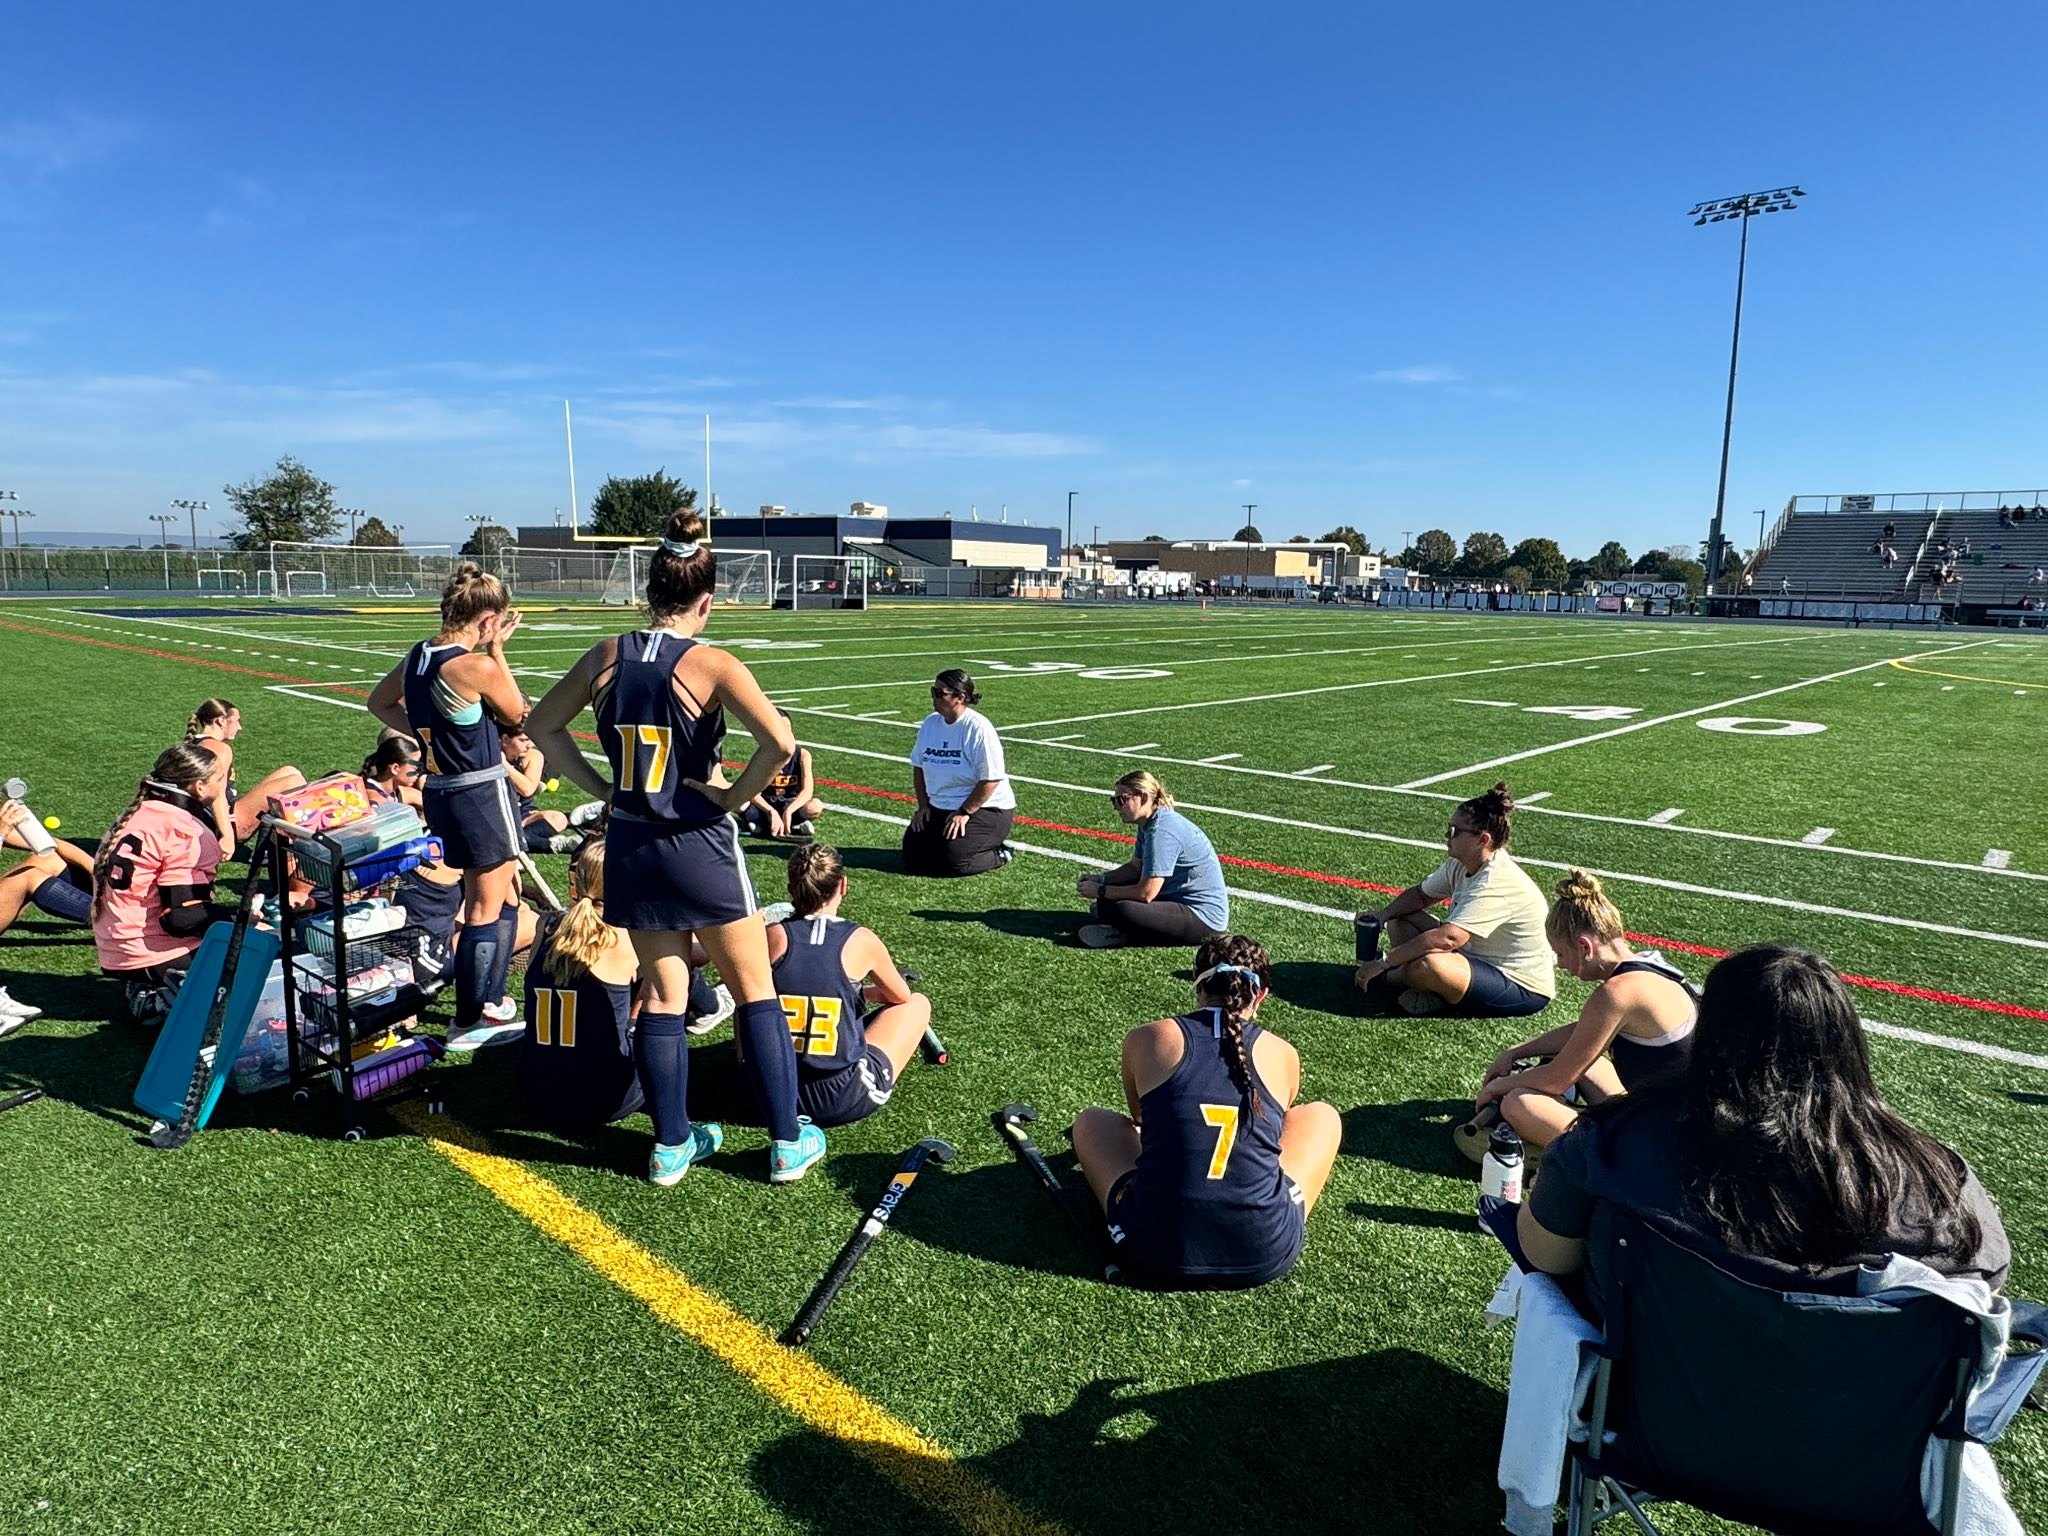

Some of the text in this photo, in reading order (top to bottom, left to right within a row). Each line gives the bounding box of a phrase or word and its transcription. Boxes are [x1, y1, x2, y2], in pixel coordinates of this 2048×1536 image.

[1521, 705, 1828, 736] 40
[614, 724, 672, 793] 17
[107, 833, 143, 891] 6
[533, 987, 578, 1047] 11
[778, 994, 842, 1056] 23
[1199, 1103, 1239, 1180] 7
